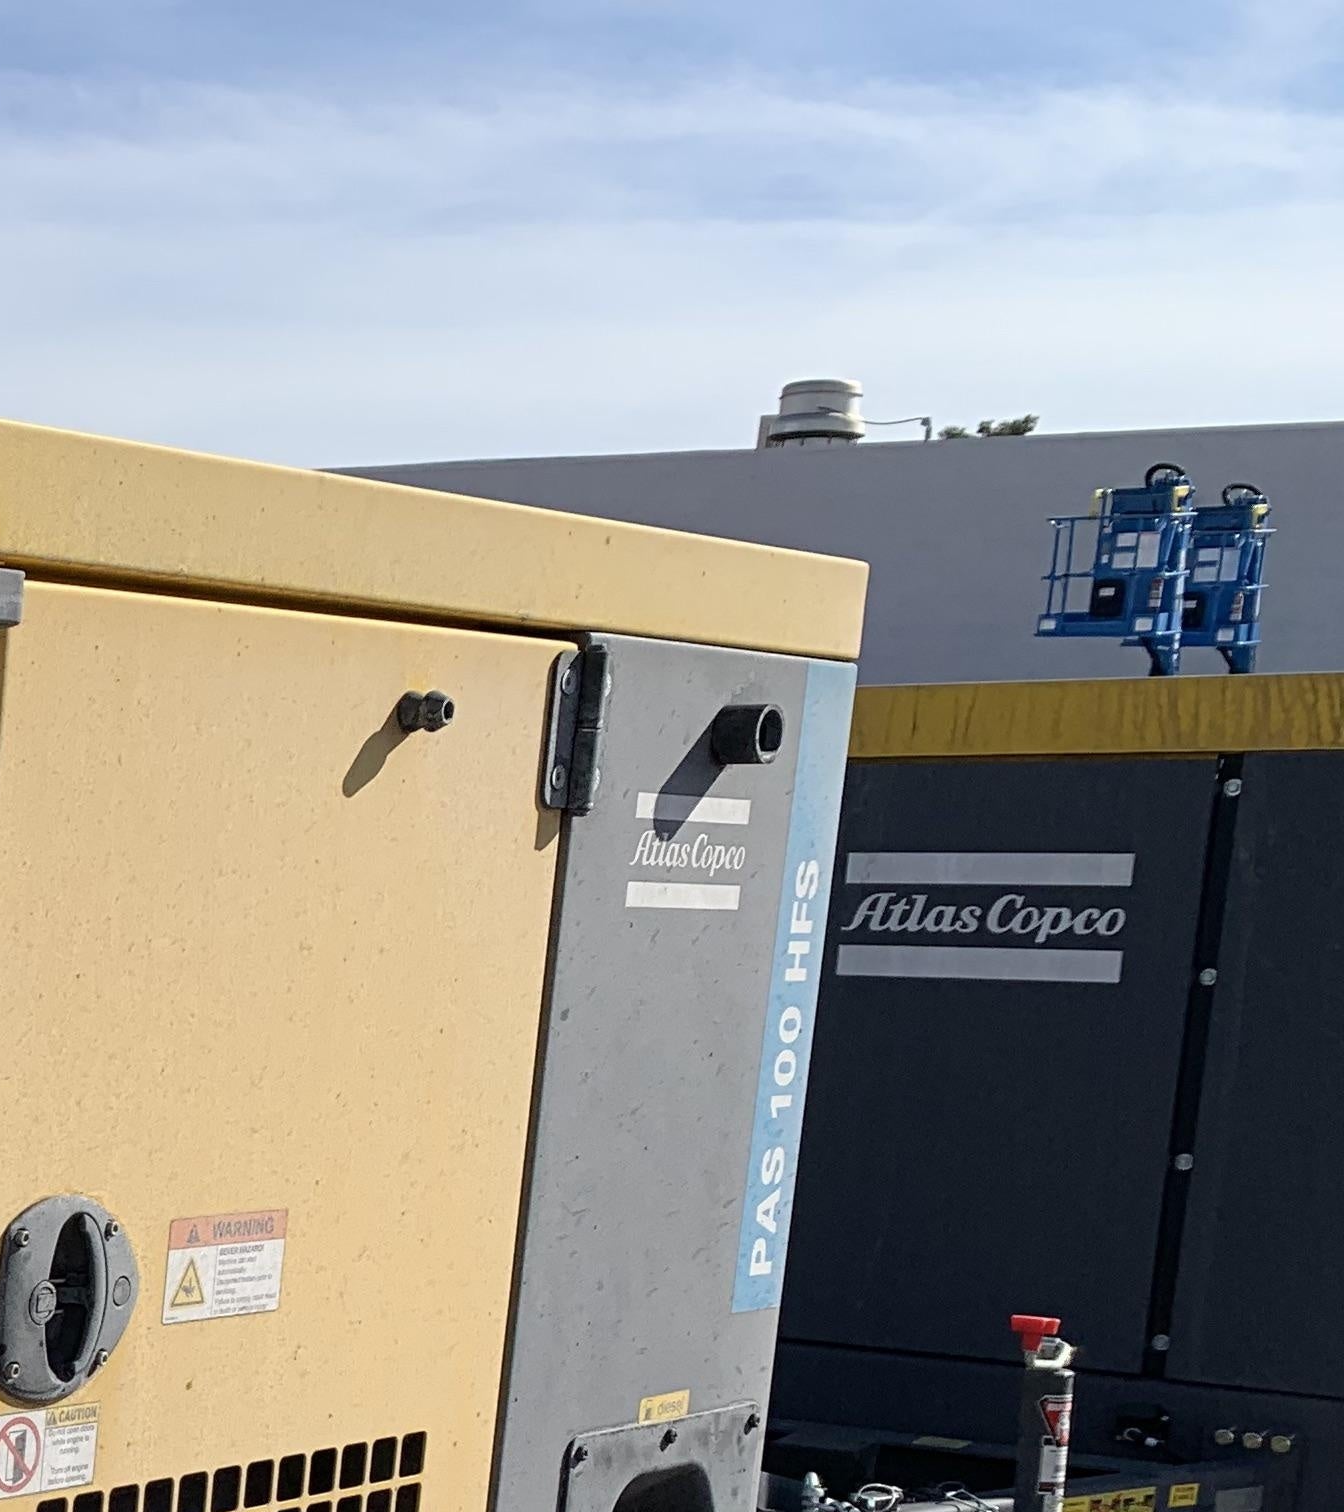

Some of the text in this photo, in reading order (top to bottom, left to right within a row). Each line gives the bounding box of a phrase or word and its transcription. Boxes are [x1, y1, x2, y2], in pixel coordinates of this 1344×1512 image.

[629, 830, 746, 877] Atlas Copco
[841, 892, 1127, 943] Atlas Copco
[749, 860, 819, 1276] PAS 100 HFS
[213, 1216, 274, 1240] WARNING
[59, 1406, 98, 1423] CAUTION
